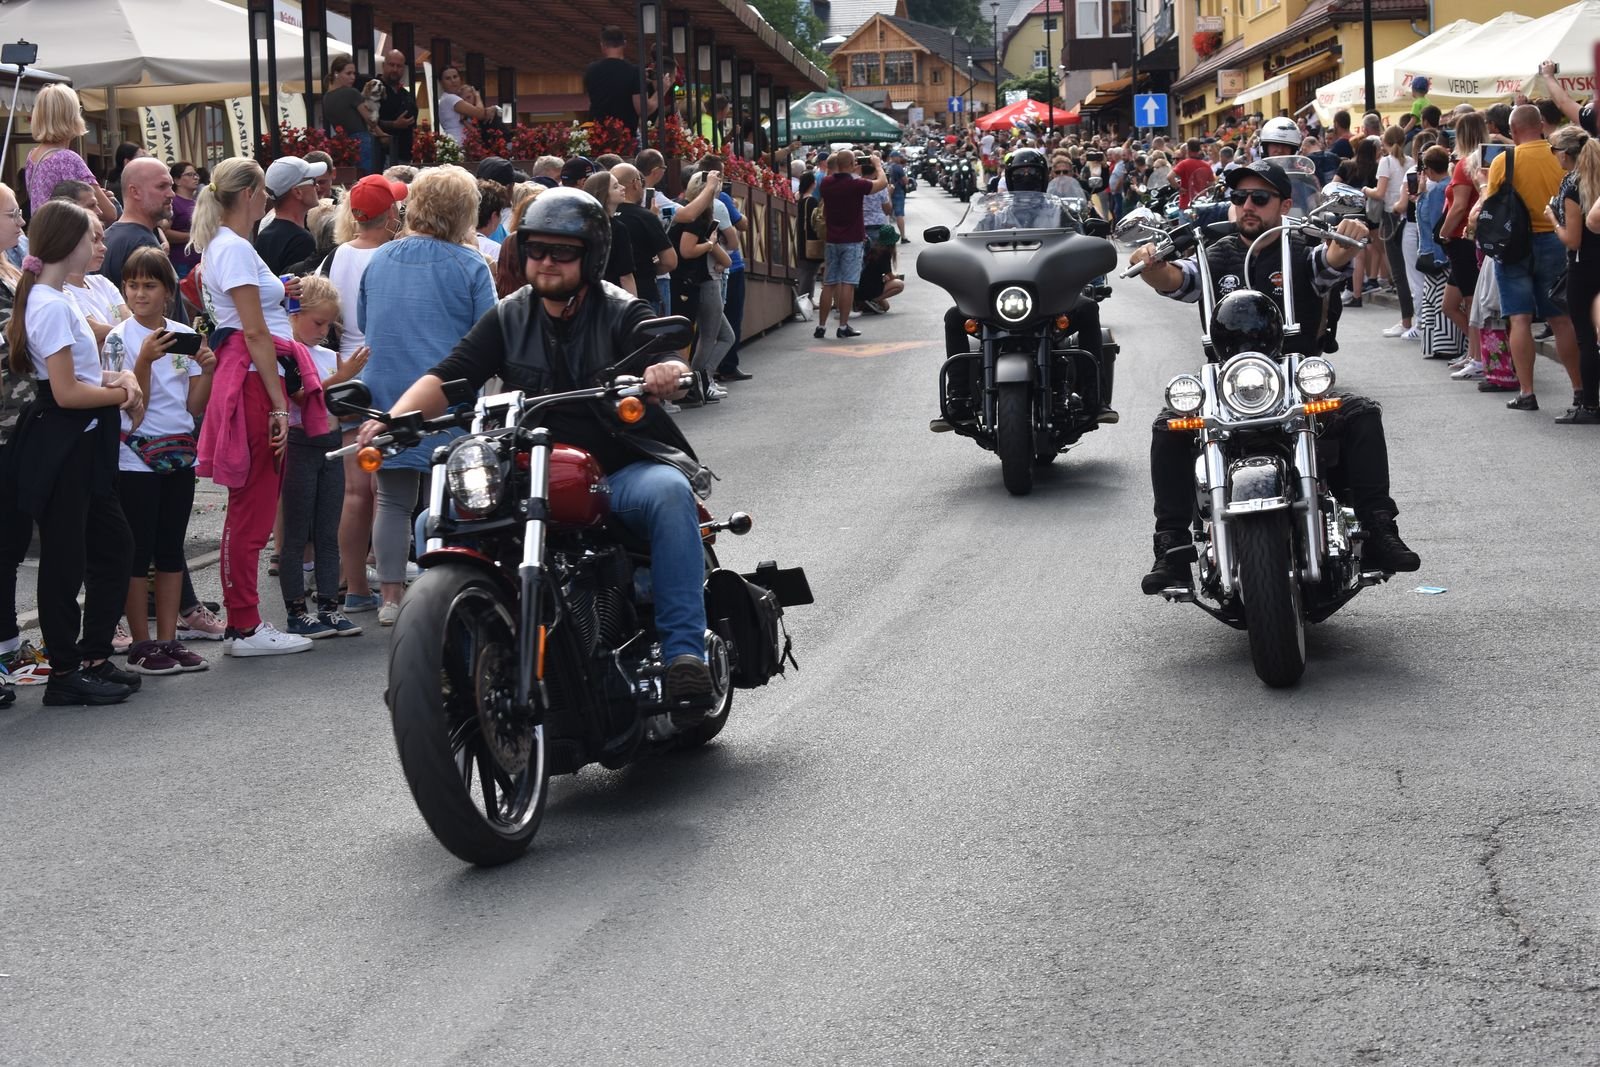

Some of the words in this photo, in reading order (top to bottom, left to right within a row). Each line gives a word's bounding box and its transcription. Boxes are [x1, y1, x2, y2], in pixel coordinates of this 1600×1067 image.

[1448, 79, 1479, 94] VERDE
[819, 103, 837, 115] R
[791, 118, 865, 130] ROHOZEC
